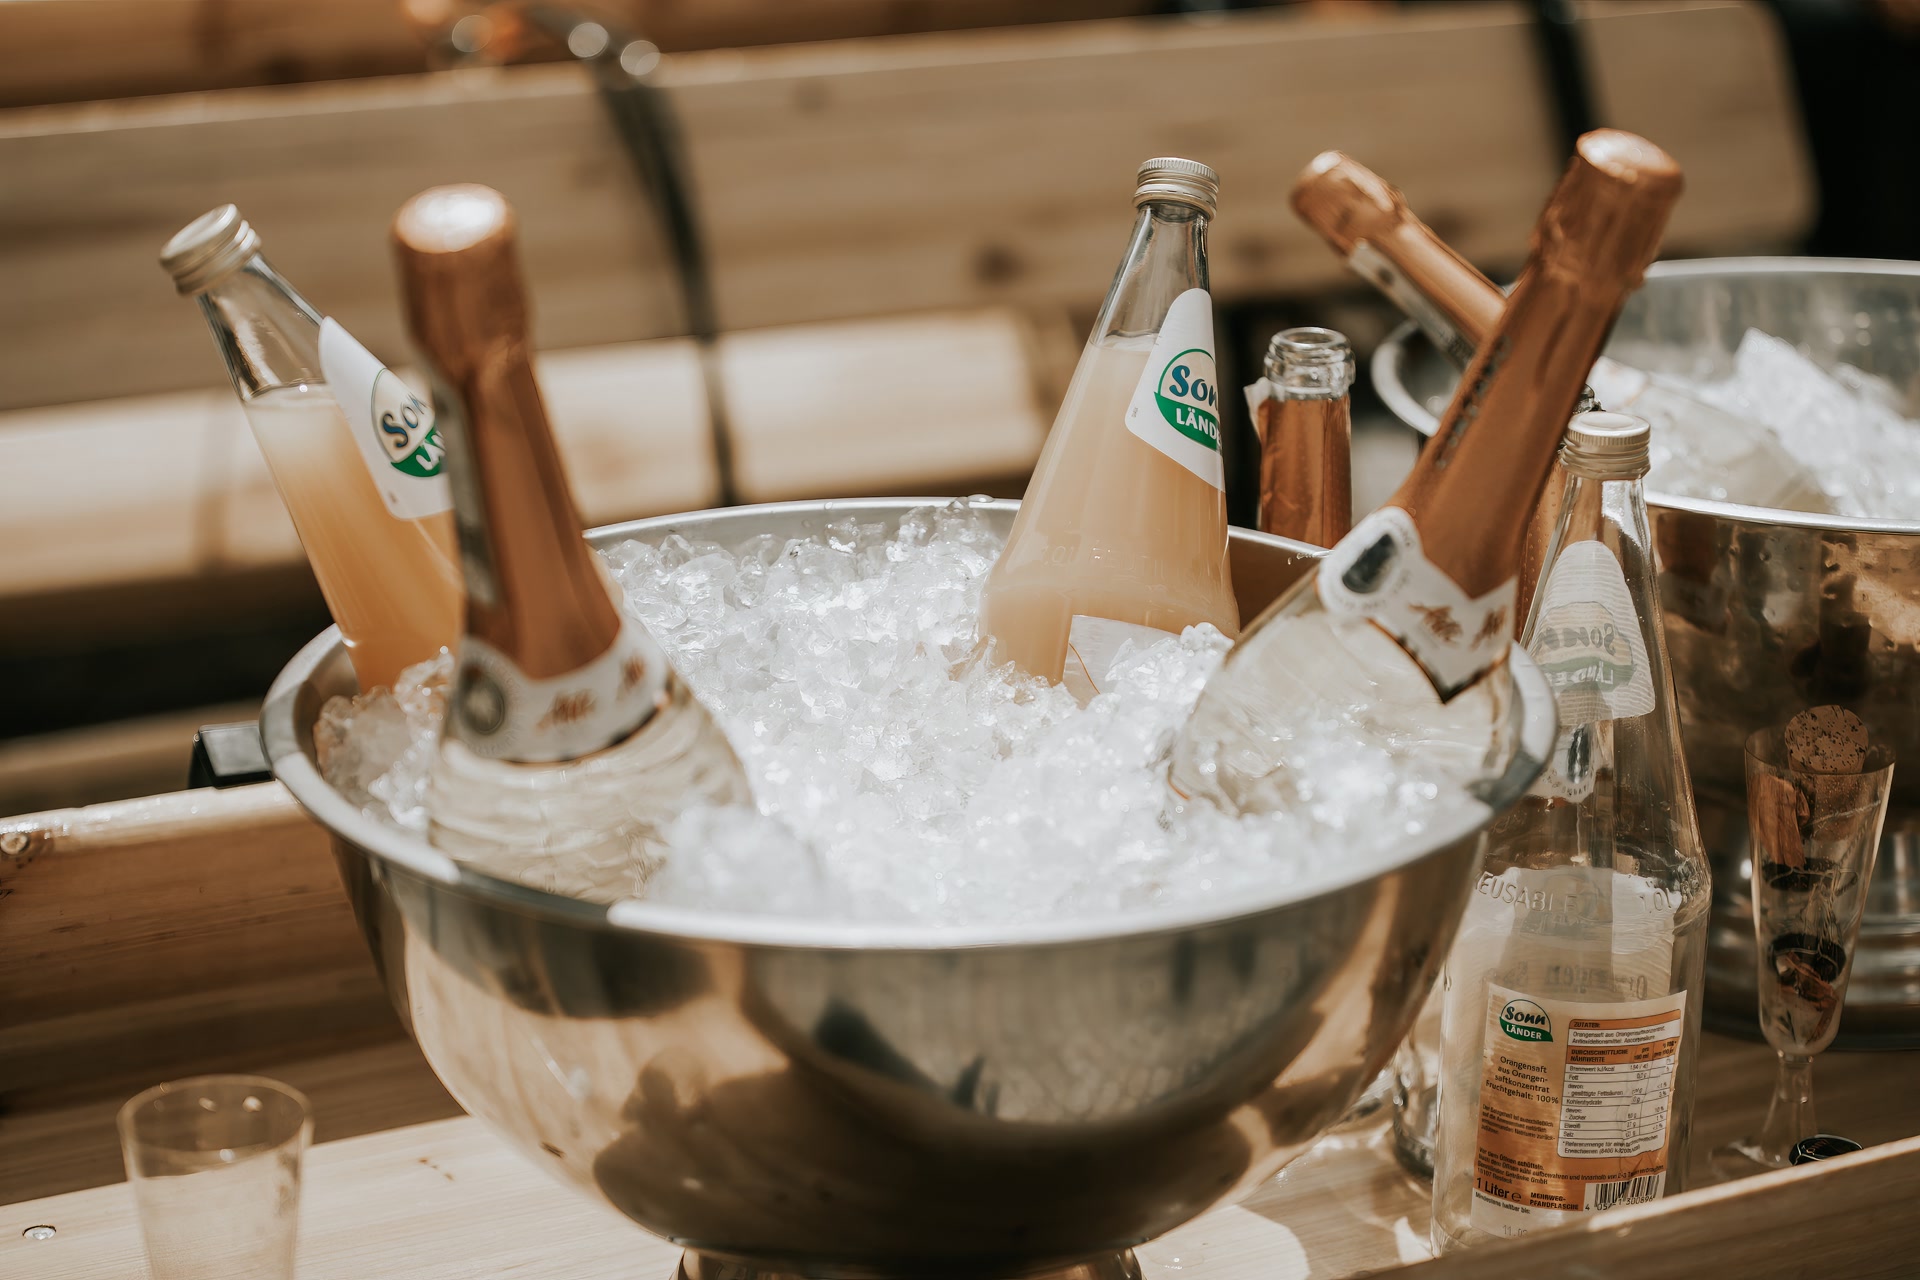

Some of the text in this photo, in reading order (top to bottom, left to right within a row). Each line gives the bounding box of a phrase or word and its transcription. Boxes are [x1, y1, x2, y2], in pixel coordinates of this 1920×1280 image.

[1505, 1006, 1546, 1025] Sonn
[1506, 1024, 1542, 1040] LÄNDER
[1500, 1056, 1547, 1073] Orangensaft
[1498, 1066, 1548, 1083] aus Orangen-
[1486, 1080, 1534, 1100] Fruchtgehalt:
[1494, 1074, 1550, 1094] saftkonzentrat
[1477, 1177, 1482, 1189] 1
[1484, 1180, 1510, 1199] Liter
[1529, 1199, 1579, 1210] PFANDFLASCHE
[1530, 1192, 1566, 1202] MEHRWEG-
